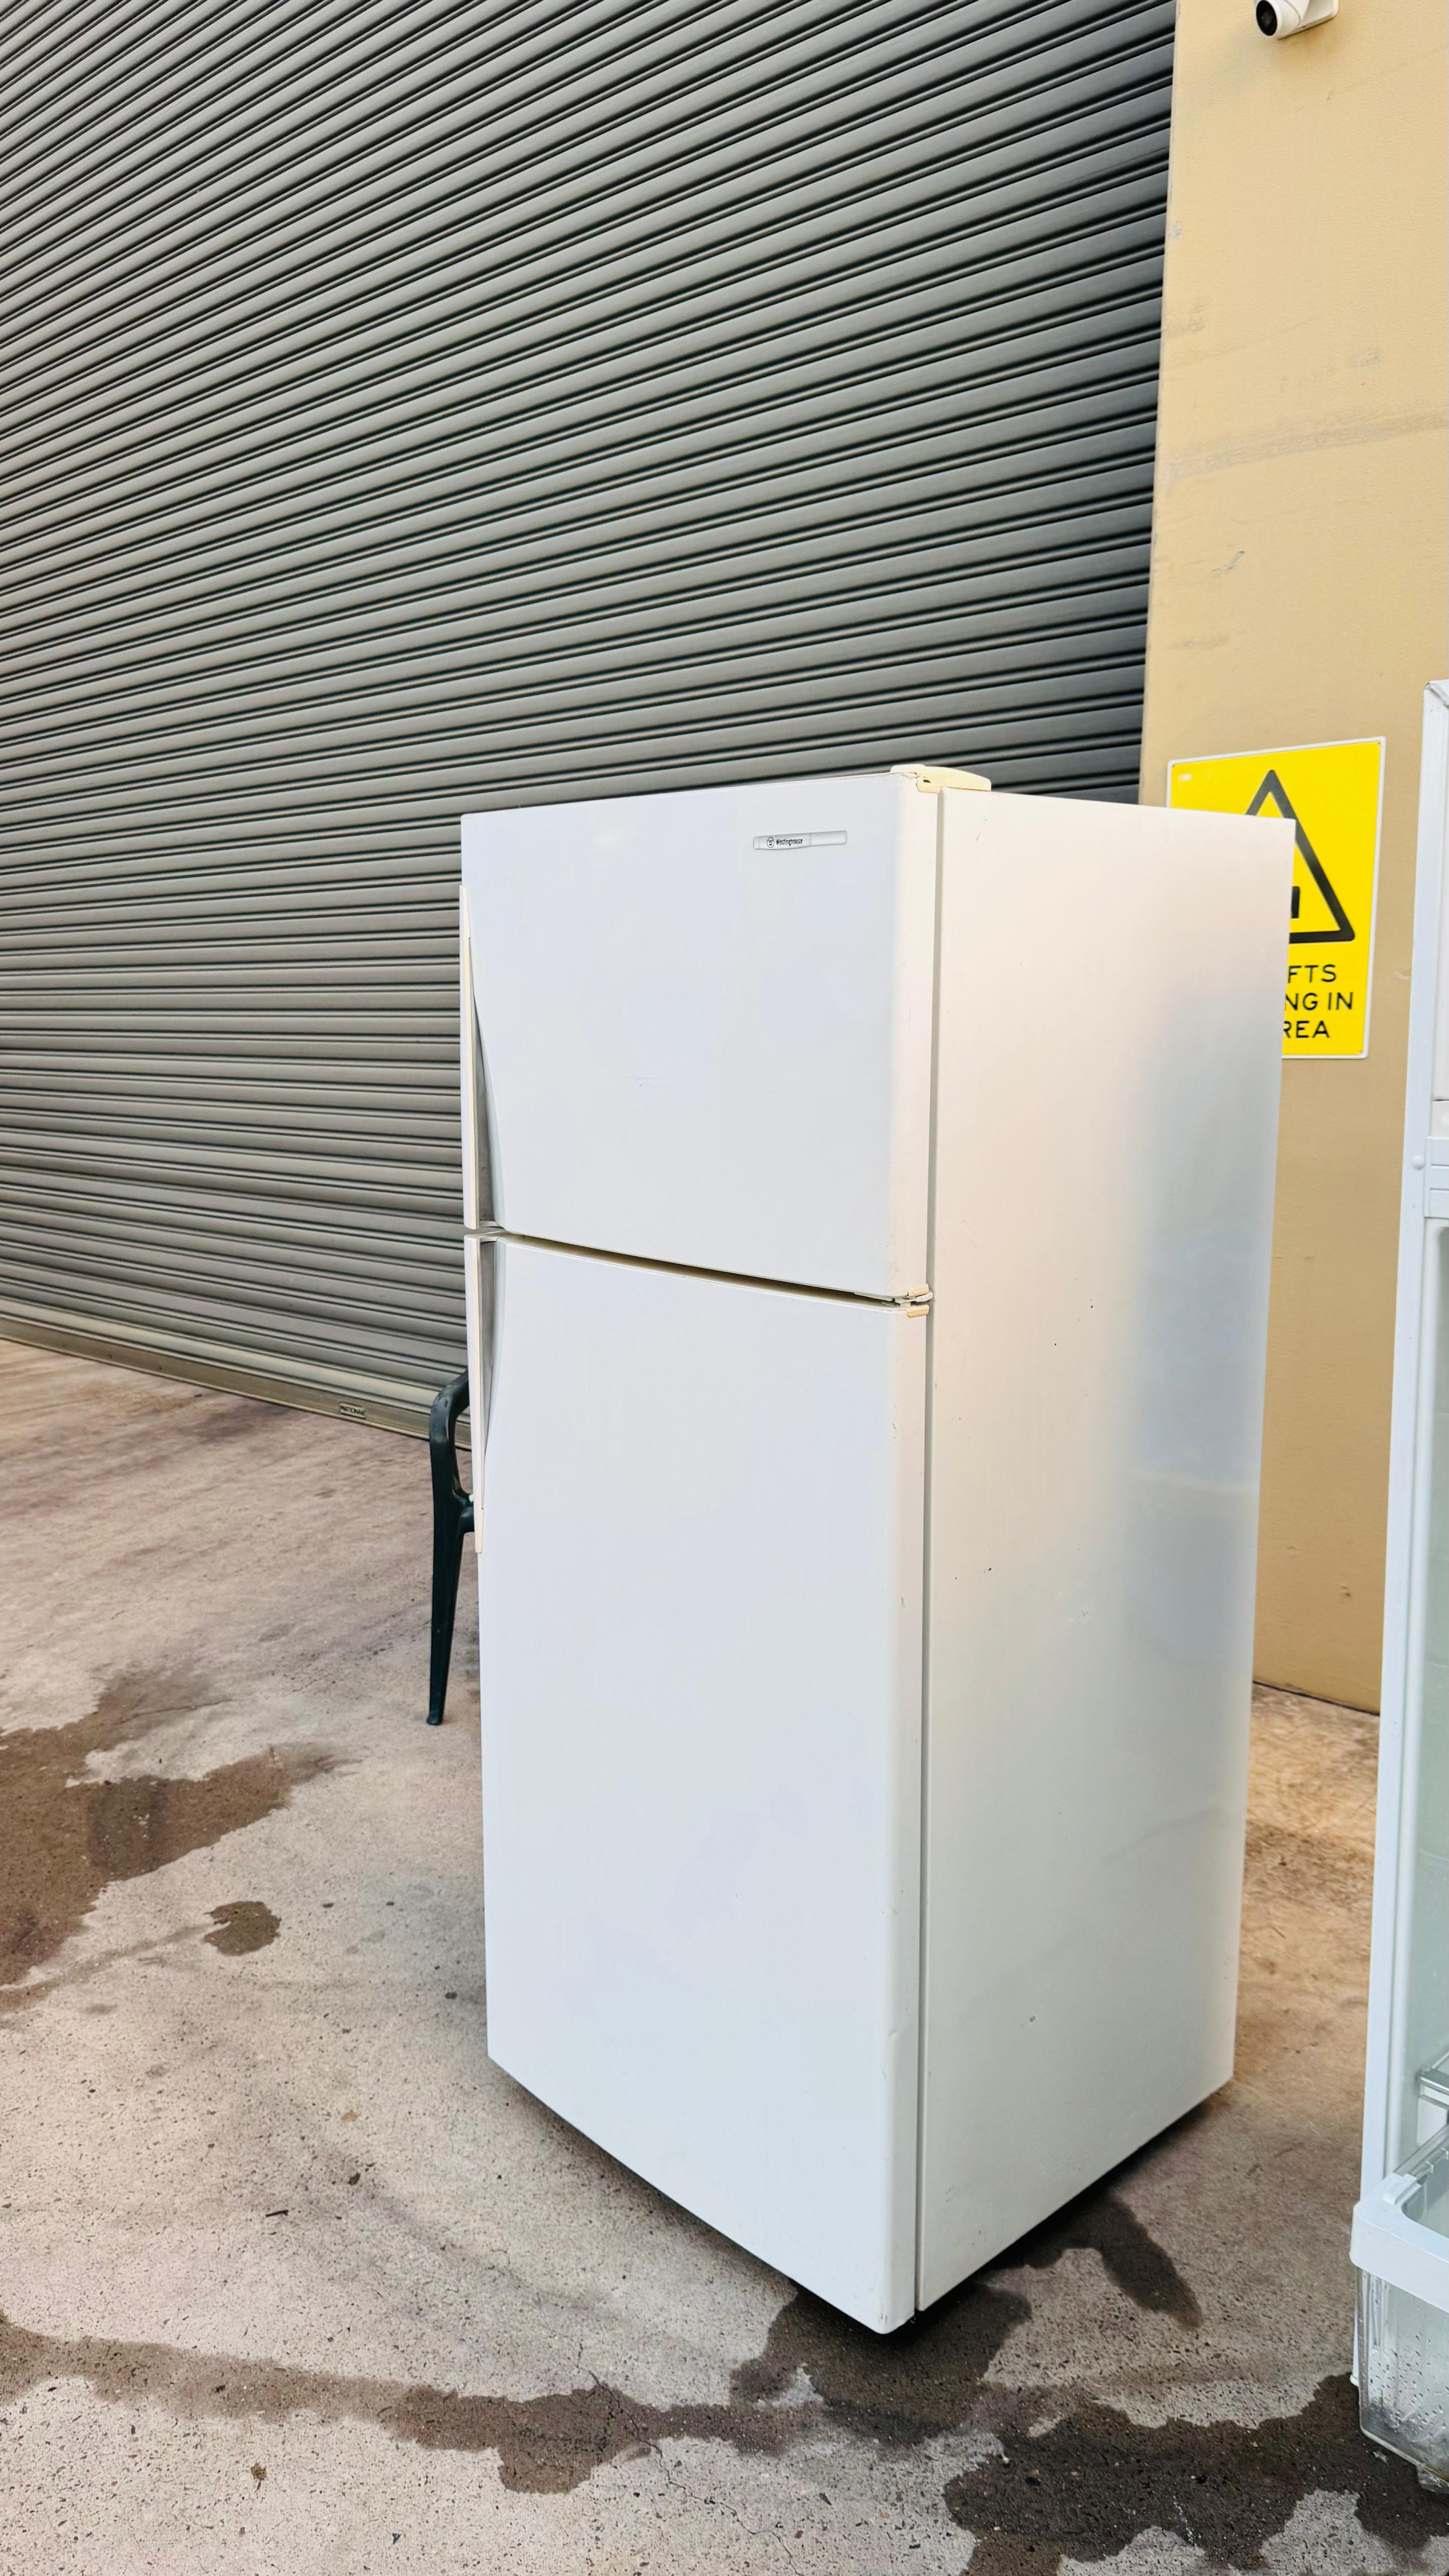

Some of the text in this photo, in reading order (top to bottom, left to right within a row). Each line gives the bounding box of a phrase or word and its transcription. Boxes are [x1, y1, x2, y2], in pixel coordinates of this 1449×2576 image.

[1287, 964, 1336, 983] FTS
[1284, 992, 1353, 1011] NG IN
[1283, 1020, 1330, 1038] REA
